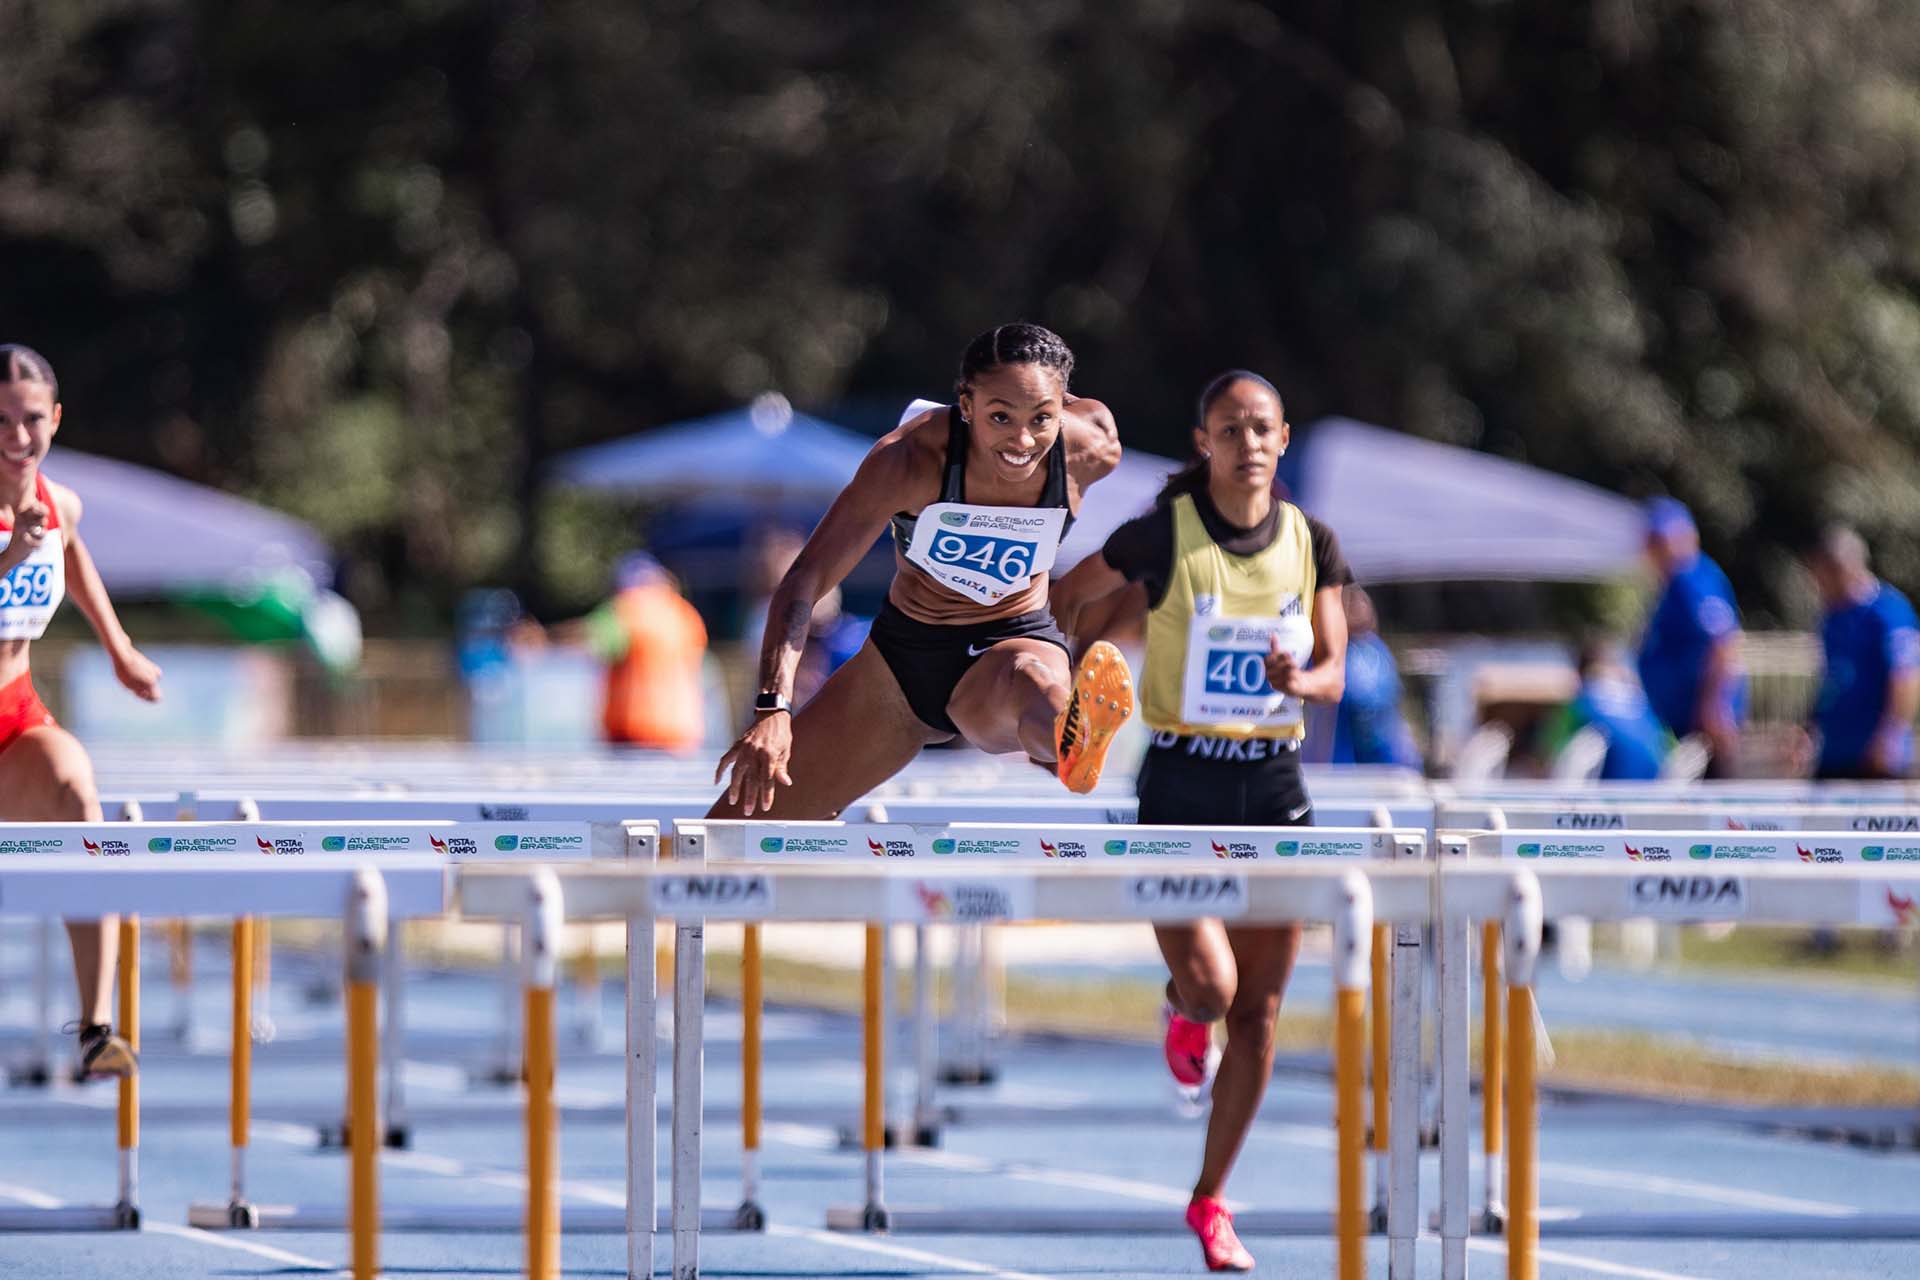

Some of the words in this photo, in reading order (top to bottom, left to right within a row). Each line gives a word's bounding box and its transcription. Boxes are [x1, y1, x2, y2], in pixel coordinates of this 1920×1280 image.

[971, 514, 1045, 526] ATLETISMO
[969, 521, 1018, 532] BRASIL
[935, 536, 1029, 582] 946
[951, 575, 987, 595] CAIXA
[1209, 654, 1267, 693] 40
[1189, 735, 1266, 759] NIKE
[1556, 813, 1624, 829] CNDA
[1852, 815, 1920, 832] CNDA
[0, 839, 63, 847] ATLETISMO
[786, 838, 848, 846] ATLETISMO
[276, 847, 304, 855] CAMPO
[449, 846, 478, 854] CAMPO
[887, 849, 915, 857] CAMPO
[1543, 844, 1605, 852] ATLETISMO
[1714, 845, 1777, 853] ATLETISMO
[1059, 850, 1087, 858] CAMPO
[1230, 851, 1258, 859] CAMPO
[1815, 855, 1844, 863] CAMPO
[661, 875, 770, 900] CNDA
[1135, 875, 1241, 898] CNDA
[1635, 875, 1742, 900] CNDA
